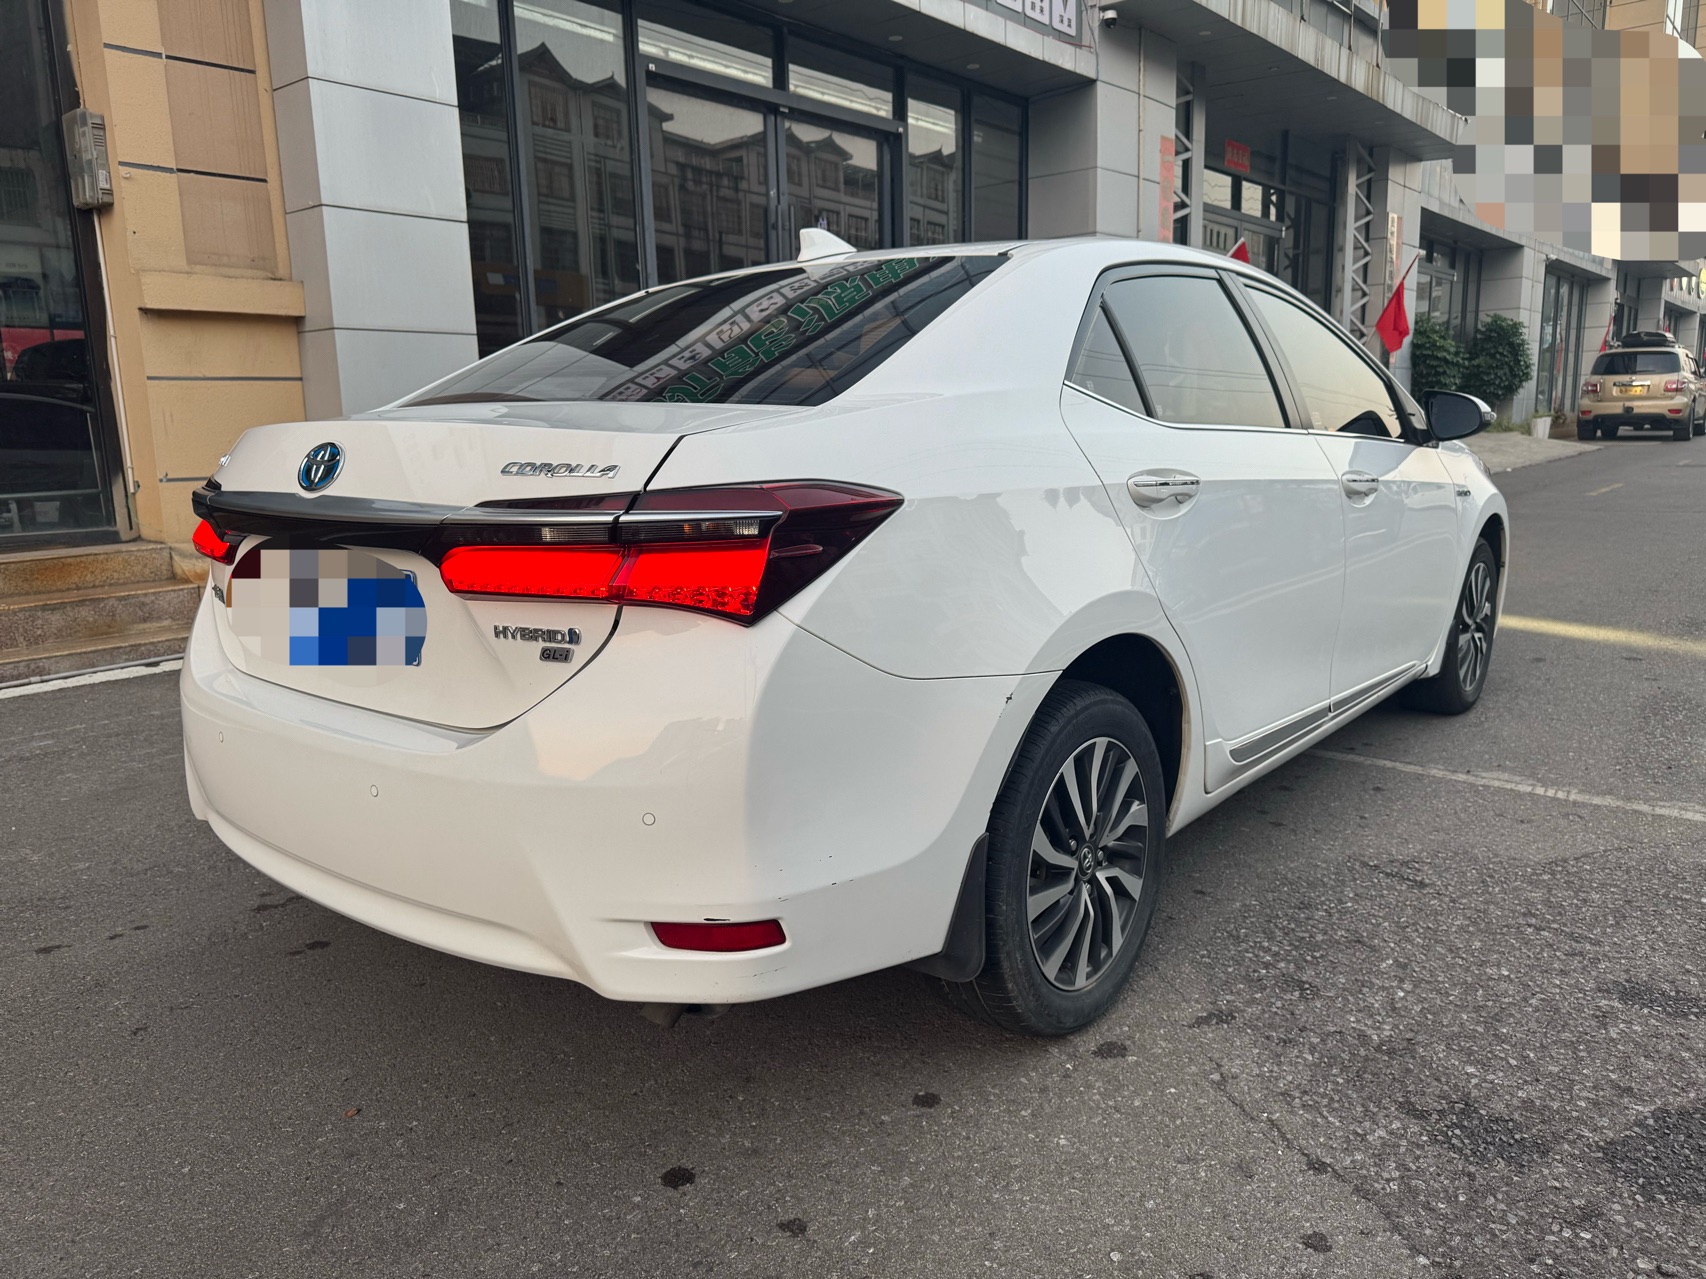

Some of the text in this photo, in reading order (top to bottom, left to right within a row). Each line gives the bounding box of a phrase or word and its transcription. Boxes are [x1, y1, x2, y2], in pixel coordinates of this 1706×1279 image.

[500, 461, 621, 479] COROLLA
[493, 624, 567, 645] HYBRID
[541, 648, 570, 661] GL-i
